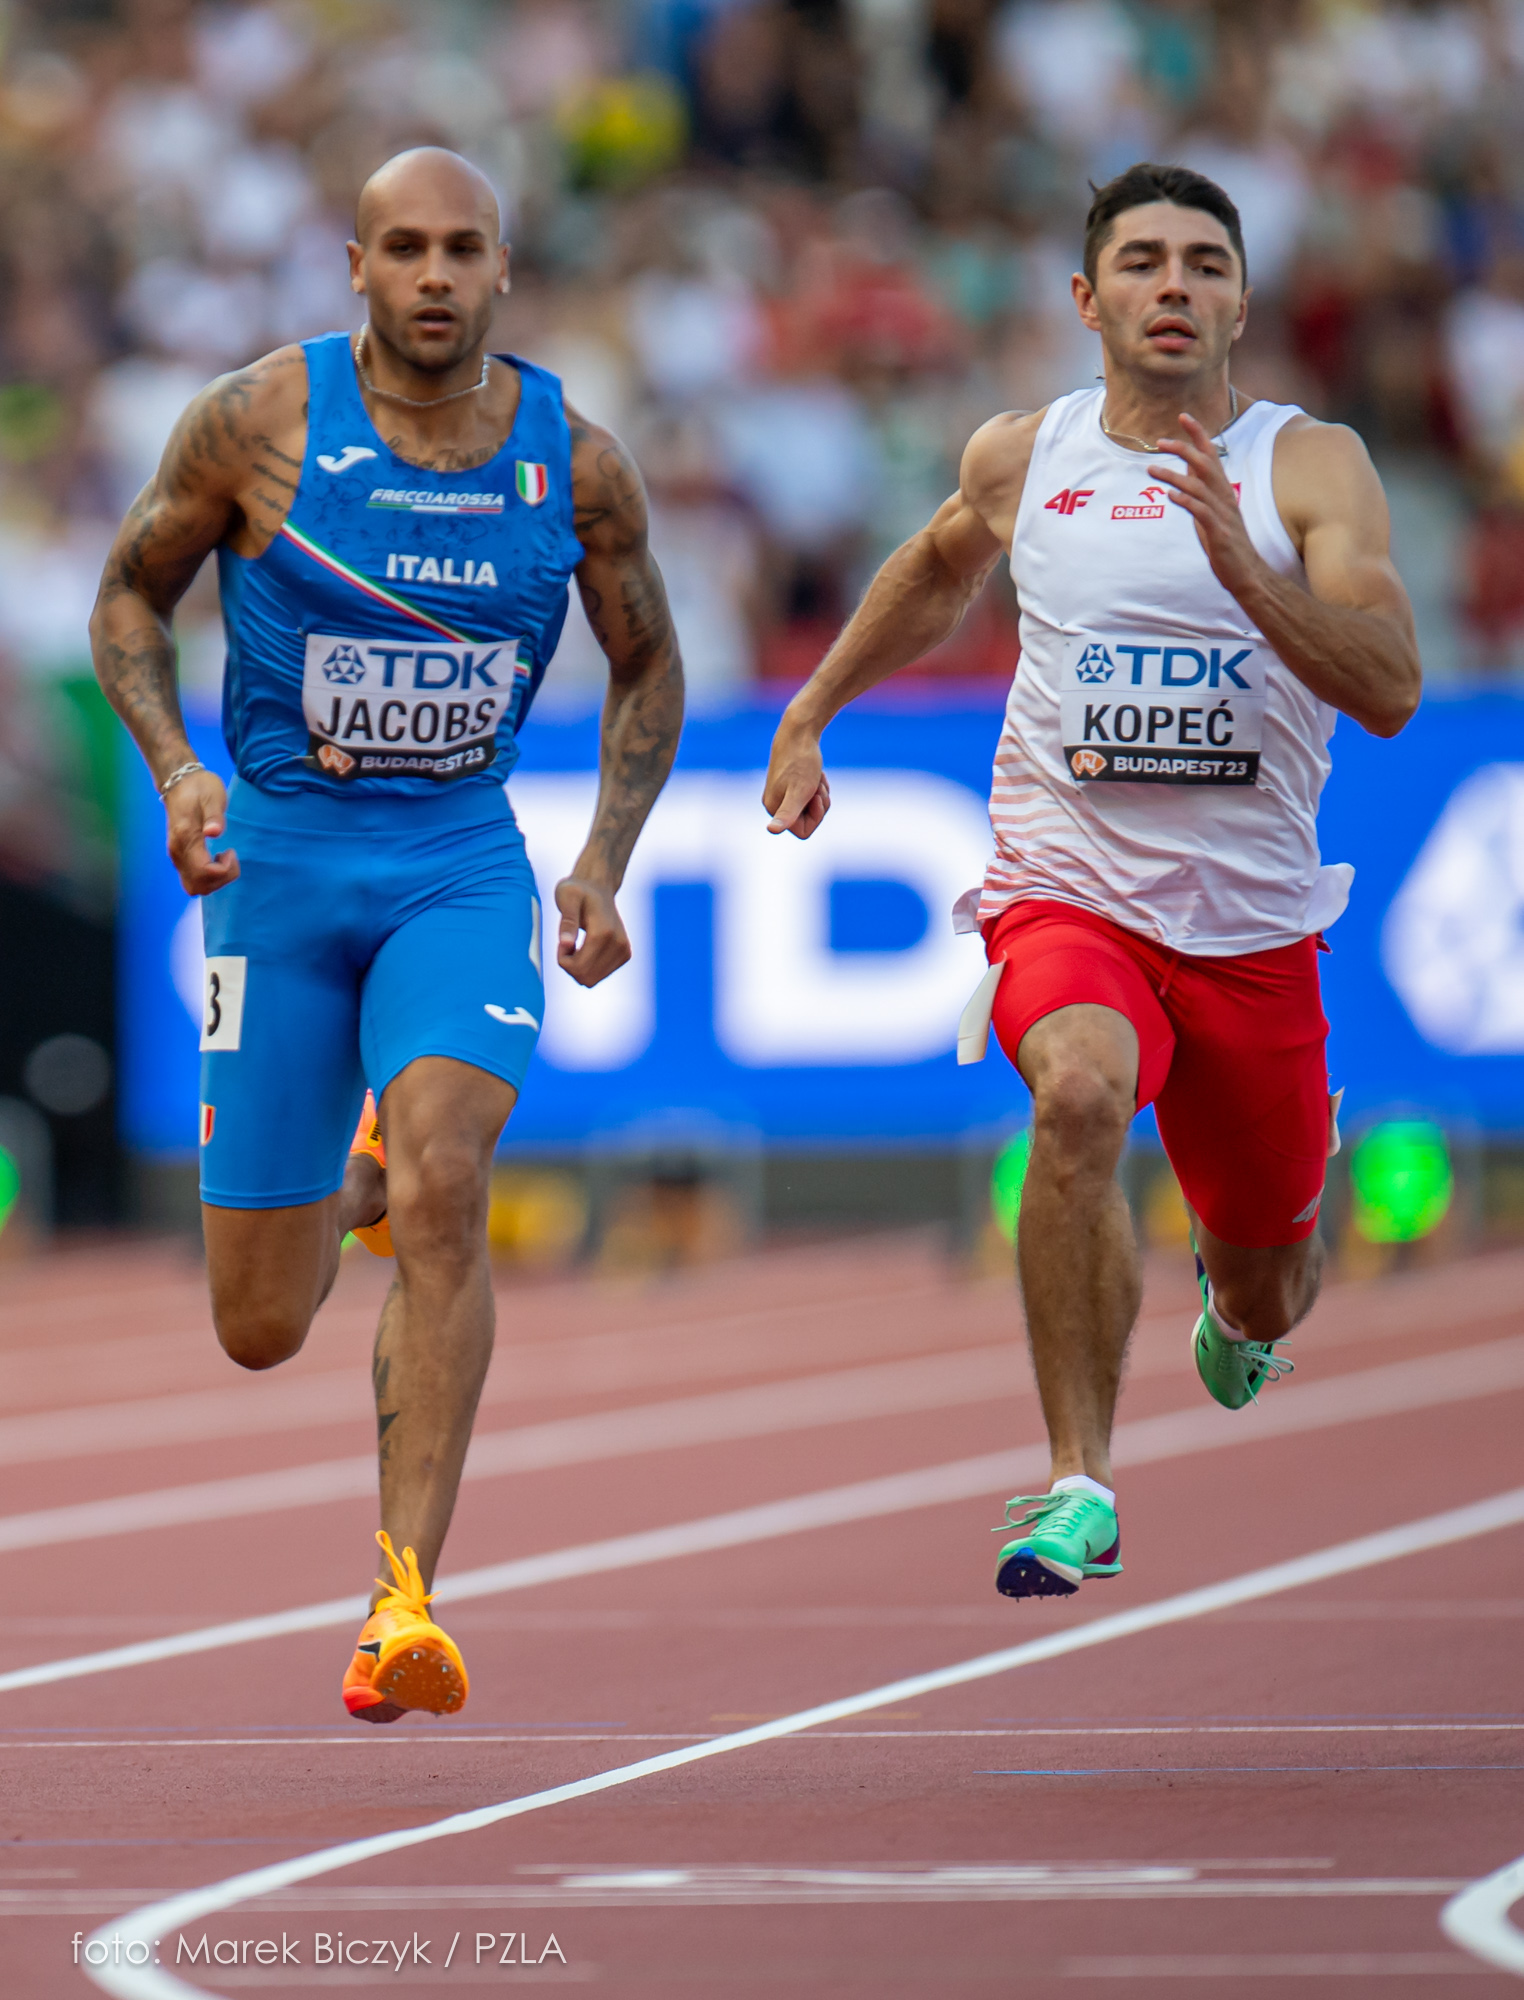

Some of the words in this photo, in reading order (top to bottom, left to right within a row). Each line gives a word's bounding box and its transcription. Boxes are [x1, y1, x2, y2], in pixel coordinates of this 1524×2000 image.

[369, 488, 505, 506] FRECCIAROSSA
[1043, 488, 1096, 515] 4F
[1113, 506, 1161, 518] ORLEN
[385, 553, 499, 587] ITALIA
[367, 647, 503, 690] TDK
[1115, 644, 1255, 690] TDK
[317, 696, 497, 744] JACOBS
[1082, 699, 1235, 747] KOPEĆ
[206, 971, 222, 1037] 3
